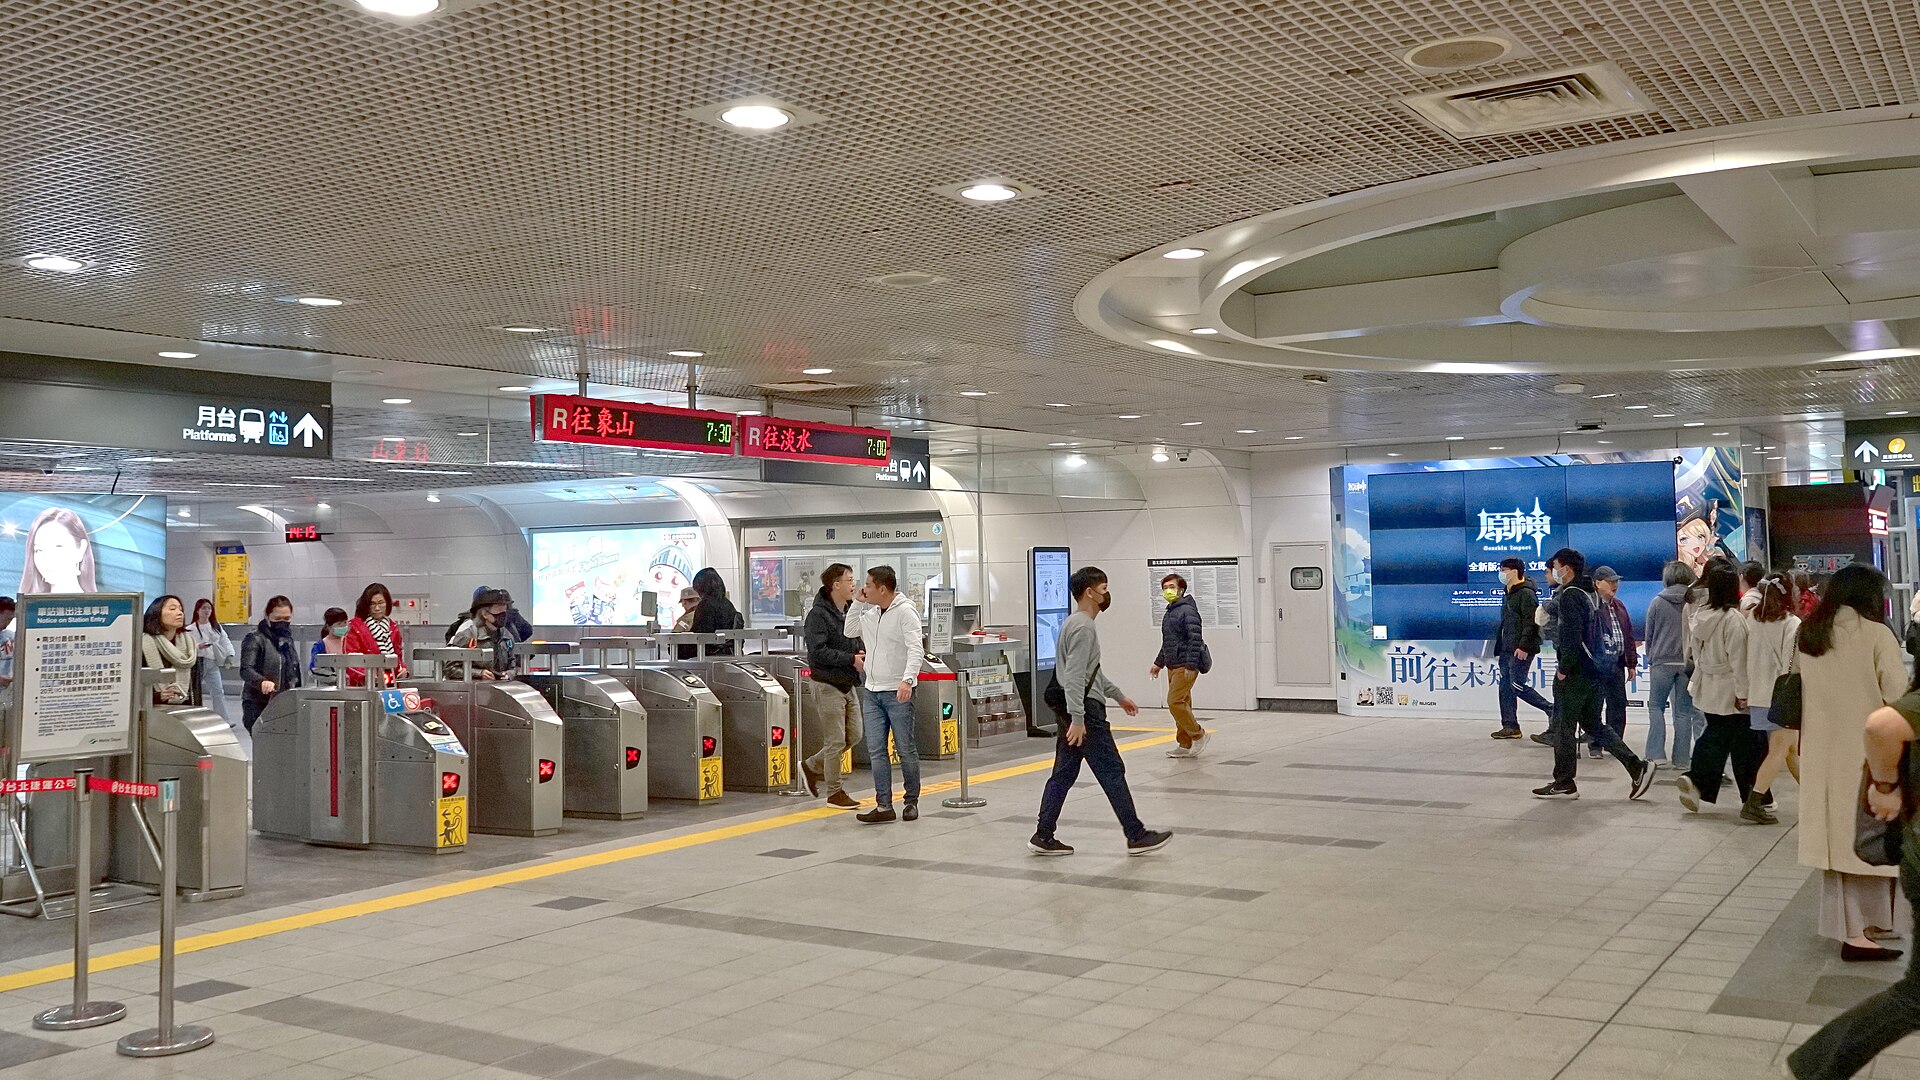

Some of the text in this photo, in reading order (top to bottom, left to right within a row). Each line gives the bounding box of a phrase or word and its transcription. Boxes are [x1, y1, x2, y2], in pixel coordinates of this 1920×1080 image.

[196, 405, 237, 429] 月台
[552, 407, 568, 430] R
[571, 405, 635, 437] 往象山
[182, 423, 237, 443] Platforms
[706, 422, 731, 443] 7:30
[749, 427, 761, 447] R
[762, 425, 813, 453] 往淡水
[867, 438, 887, 457] 7:00
[289, 525, 316, 539] 14:15
[862, 531, 890, 539] Bulletin
[895, 530, 918, 539] Board
[1476, 497, 1551, 557] 原神
